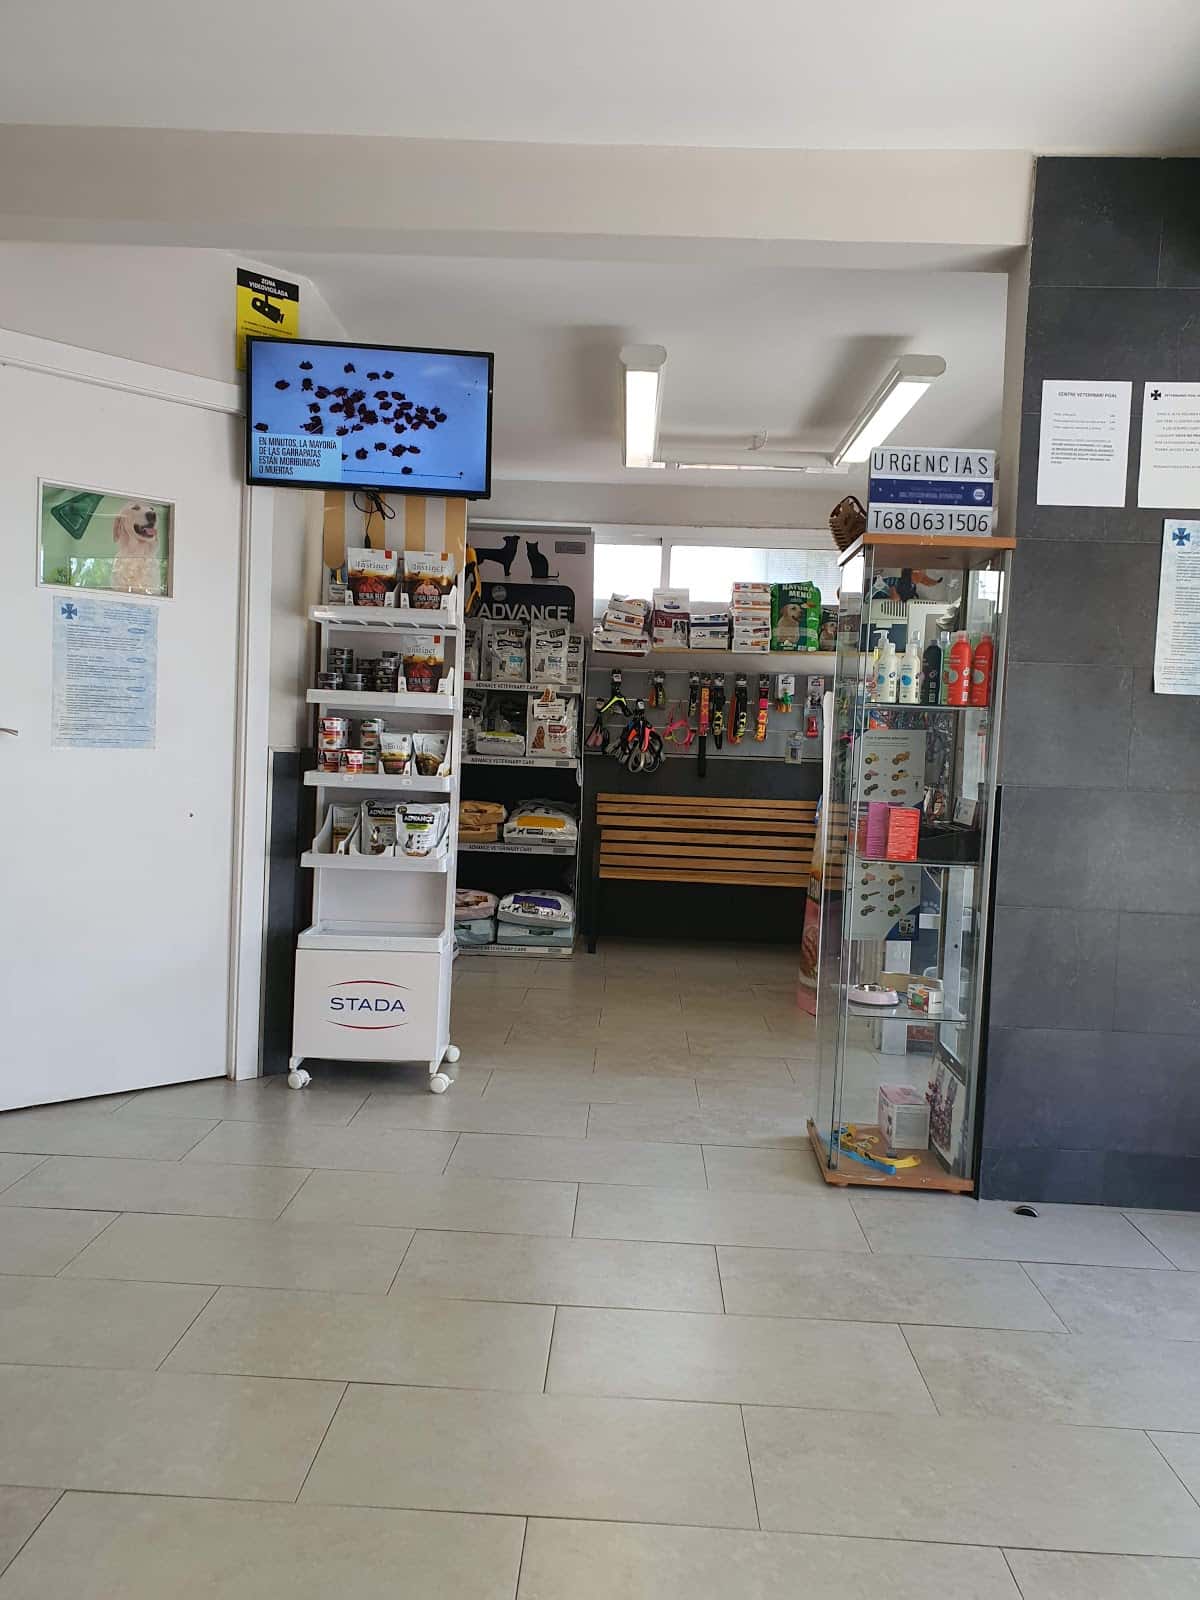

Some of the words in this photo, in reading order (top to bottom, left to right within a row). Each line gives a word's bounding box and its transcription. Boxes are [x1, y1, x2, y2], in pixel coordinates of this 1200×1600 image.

[248, 281, 289, 297] VIDEOVIGILADA
[258, 437, 267, 446] EN
[299, 439, 308, 448] LA
[258, 446, 267, 455] DE
[268, 447, 281, 456] LAS
[281, 448, 322, 458] GARRAPATAS
[279, 456, 321, 467] MORIBUNDAS
[873, 452, 989, 475] URGENCIAS
[258, 465, 264, 474] O
[265, 466, 294, 475] MUERTAS
[477, 602, 569, 621] ADVANCE
[403, 814, 434, 824] ADVANCE
[329, 997, 406, 1012] STADA
